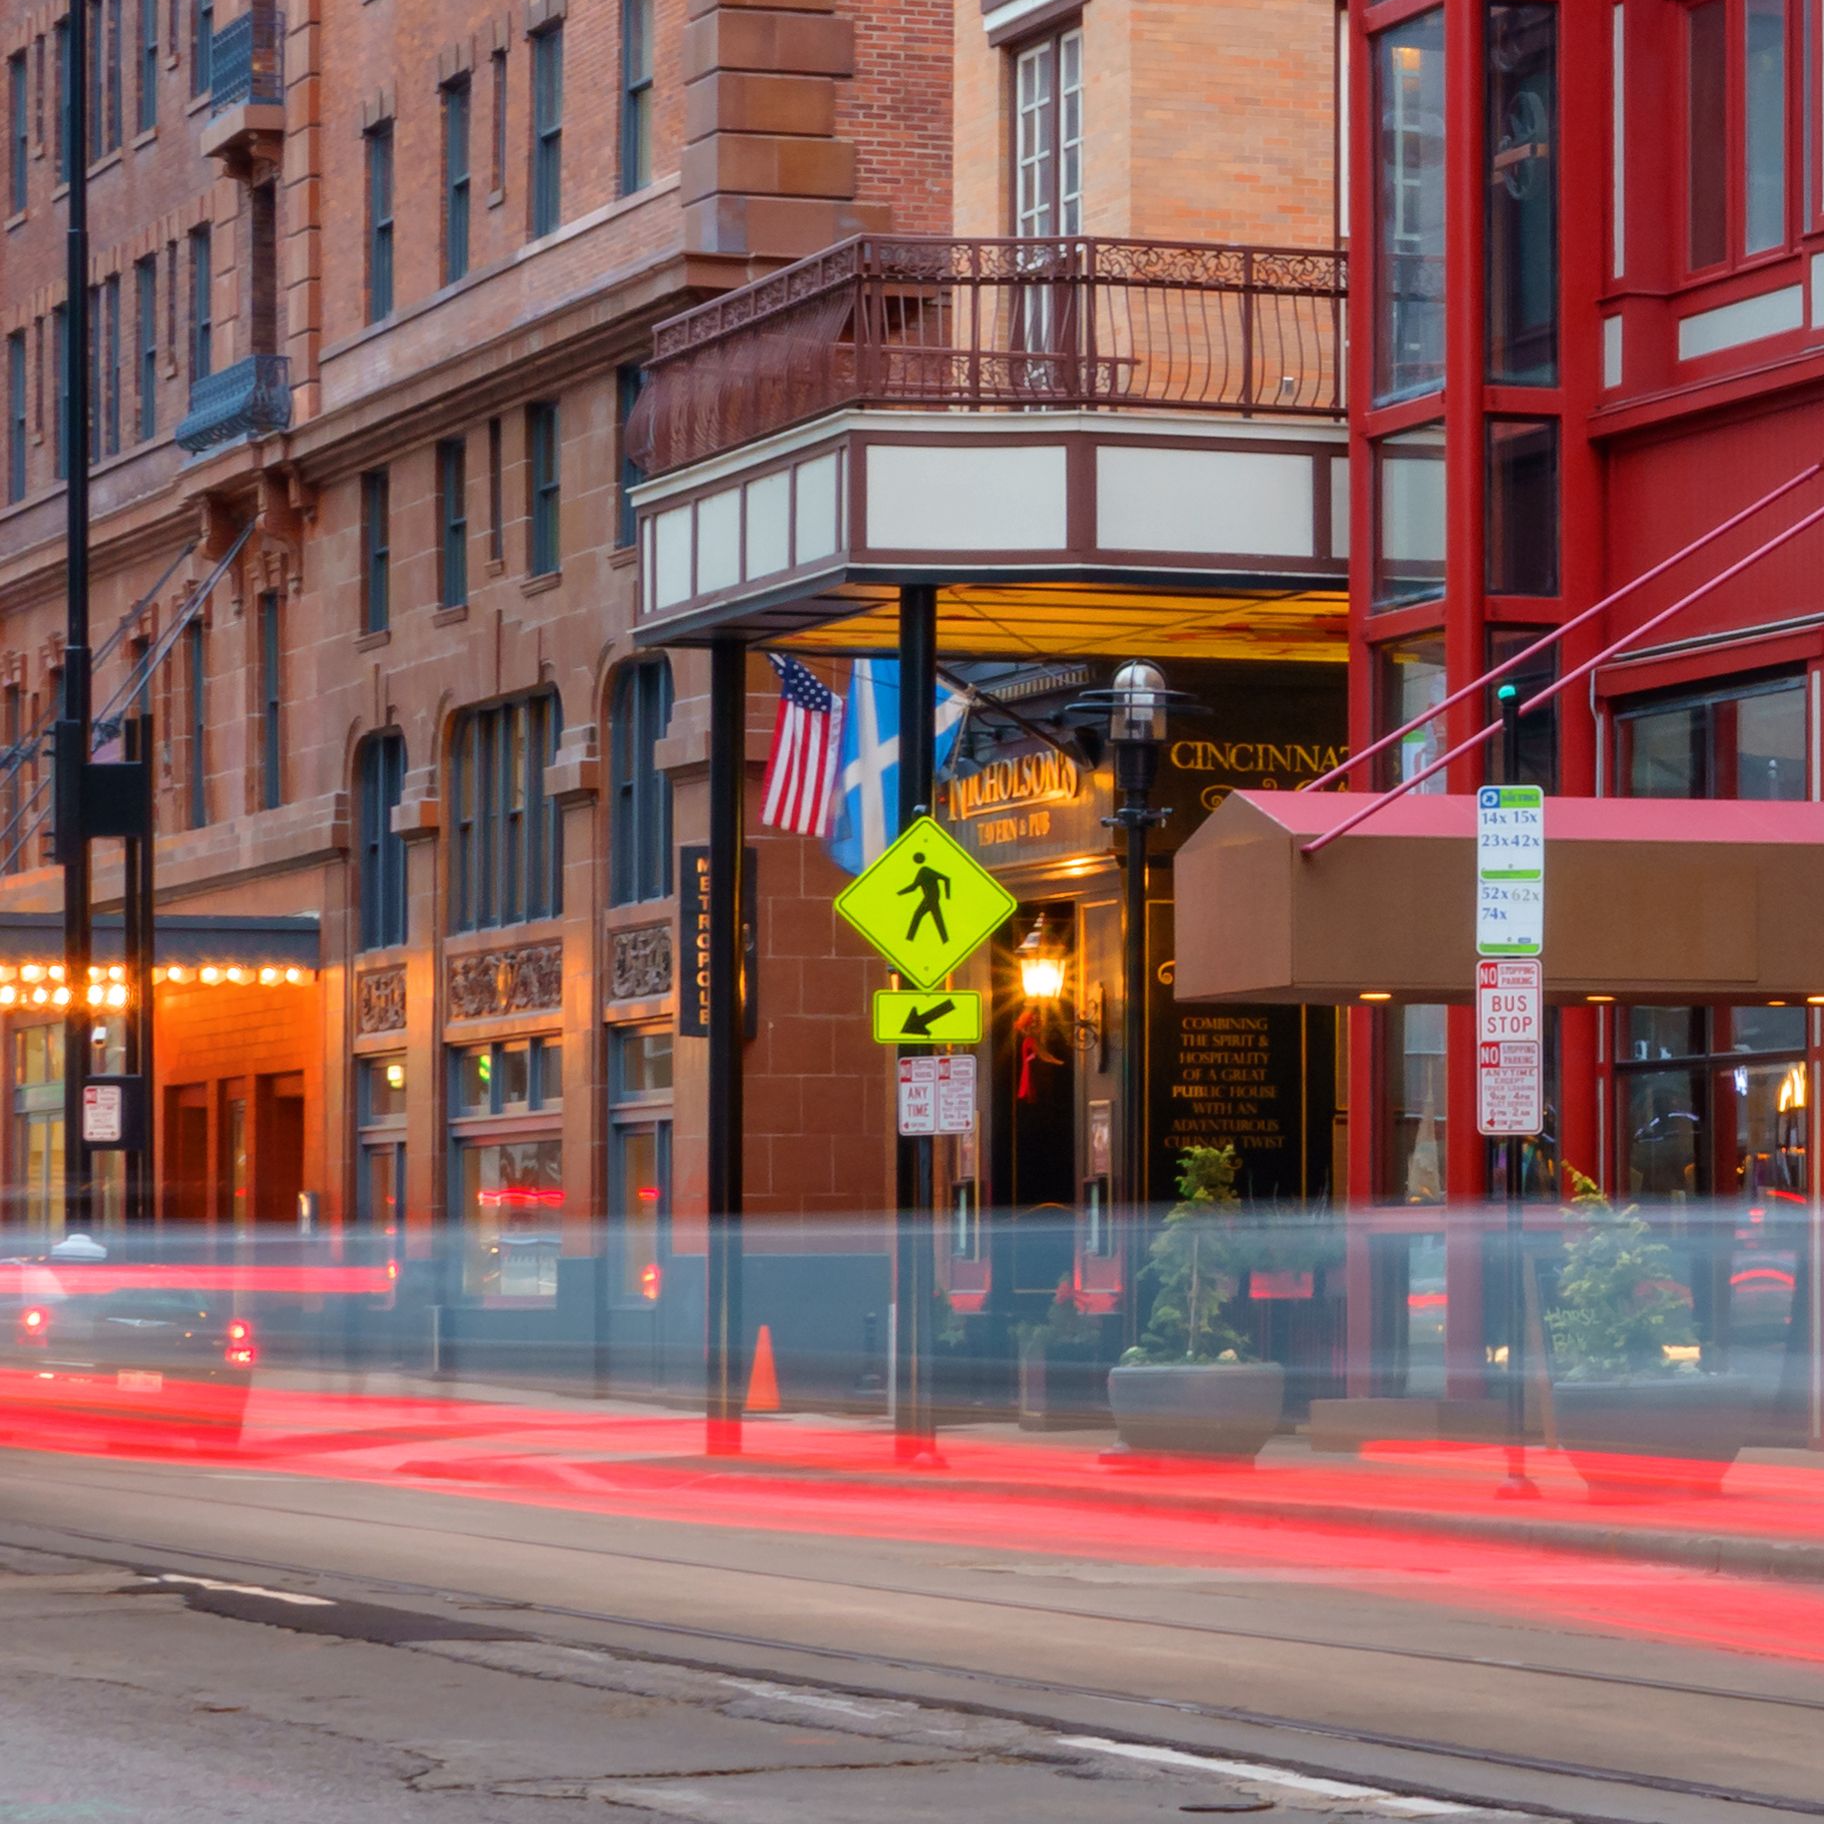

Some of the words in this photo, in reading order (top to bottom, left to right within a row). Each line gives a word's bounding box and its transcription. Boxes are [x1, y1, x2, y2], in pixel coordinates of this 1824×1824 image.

[1170, 740, 1349, 773] CINCINNA
[977, 817, 1018, 847] TAVERN
[1028, 811, 1050, 837] PUB
[697, 857, 710, 1024] METROPOLE
[1480, 967, 1497, 984] NO
[1492, 995, 1527, 1012] BUS
[1182, 1017, 1268, 1030] COMBINING
[1487, 1016, 1532, 1034] STOP
[1181, 1034, 1208, 1047] THE
[1212, 1034, 1255, 1047] SPIRIT
[1179, 1052, 1271, 1064] HOSPITALITY
[1481, 1046, 1499, 1064] NO
[1183, 1069, 1202, 1081] OF
[1210, 1069, 1217, 1081] A
[1222, 1069, 1267, 1081] GREAT
[907, 1087, 928, 1099] ANY
[1172, 1086, 1225, 1098] PUBLIC
[1230, 1086, 1278, 1098] HOUSE
[907, 1103, 929, 1117] TIME
[1193, 1102, 1232, 1114] WITH
[1236, 1102, 1258, 1114] AN
[1172, 1119, 1280, 1132] ADVENTUROUS
[1242, 1136, 1285, 1149] TWIST
